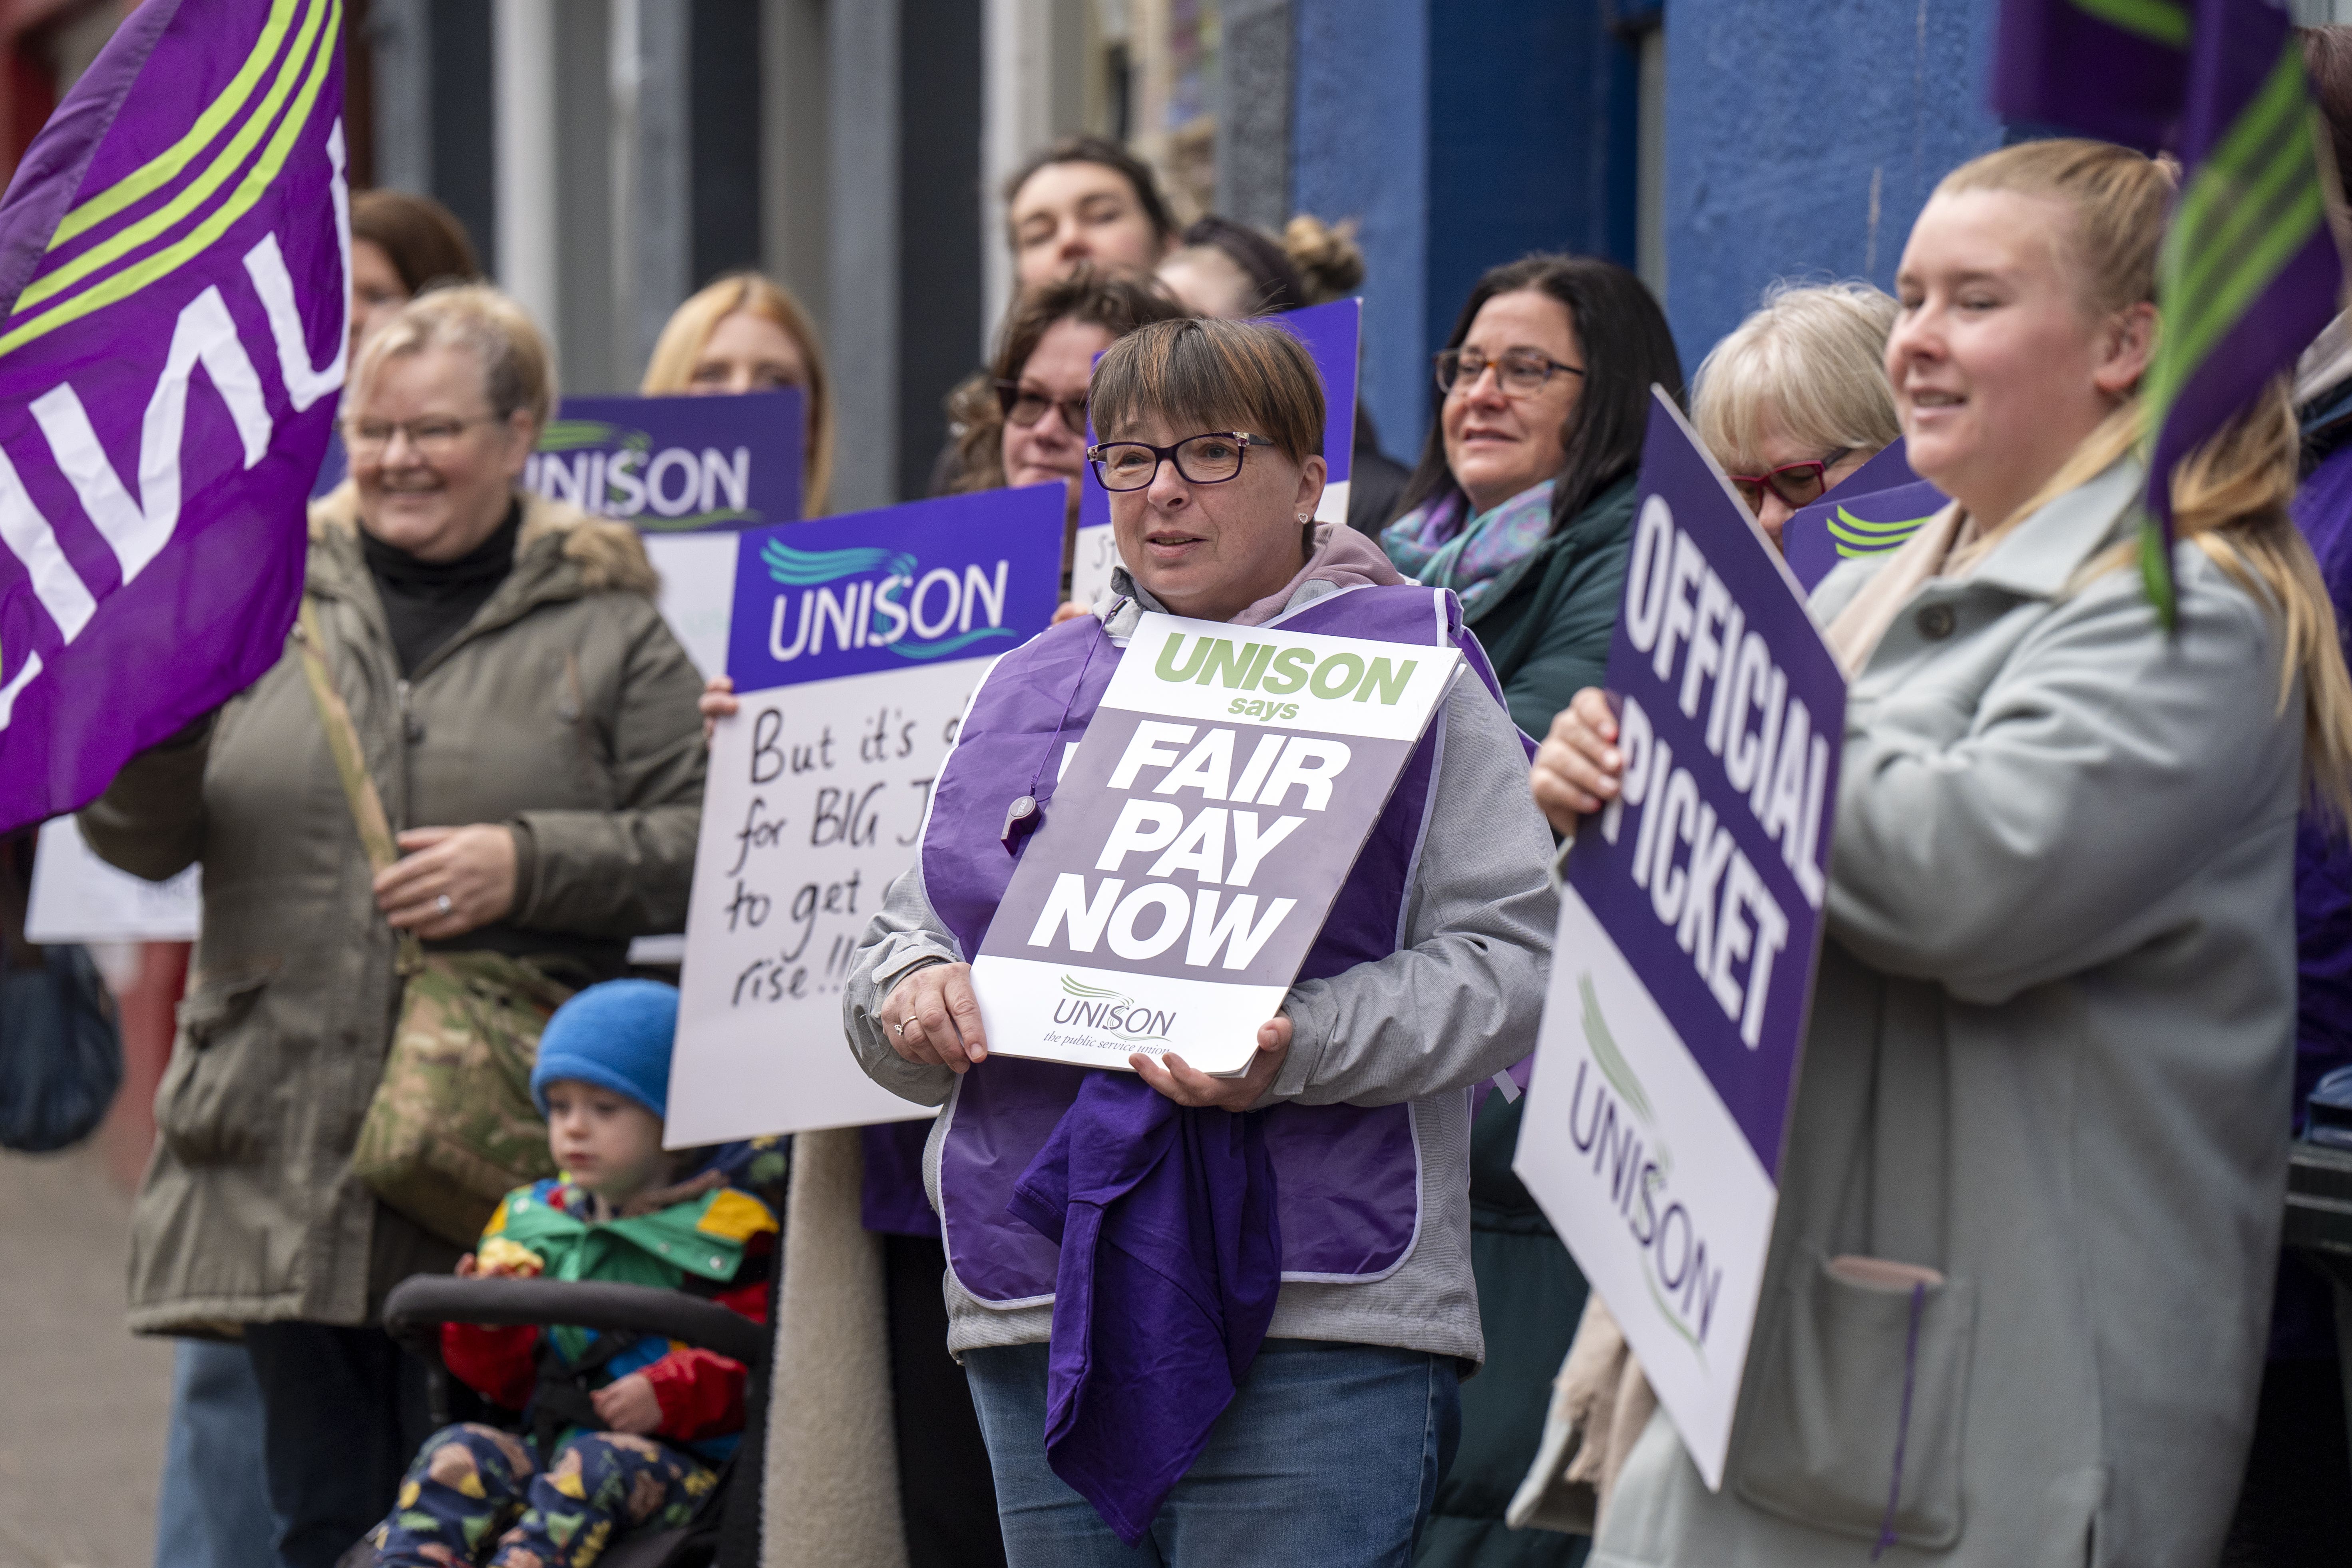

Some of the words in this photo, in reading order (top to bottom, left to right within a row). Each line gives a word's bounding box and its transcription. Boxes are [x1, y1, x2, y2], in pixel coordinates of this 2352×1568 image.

[769, 559, 1009, 662] UNISON
[1155, 632, 1418, 705] UNISON
[1228, 697, 1299, 721] says
[1625, 493, 1829, 910] OFFICIAL
[750, 706, 837, 784] But
[860, 706, 917, 764] it's
[1106, 720, 1351, 811] FAIR
[726, 795, 787, 878] for
[810, 782, 885, 847] BIG
[1094, 798, 1307, 887] PAY
[1602, 695, 1789, 1050] PICKET
[724, 879, 771, 931] to
[782, 870, 861, 963] get
[1027, 872, 1297, 970] NOW
[1043, 1031, 1061, 1043] the
[1060, 1034, 1097, 1048] public
[1097, 1041, 1136, 1052] service
[1137, 1046, 1170, 1055] union
[1053, 998, 1176, 1036] UNISON
[1569, 1060, 1723, 1343] UNISON
